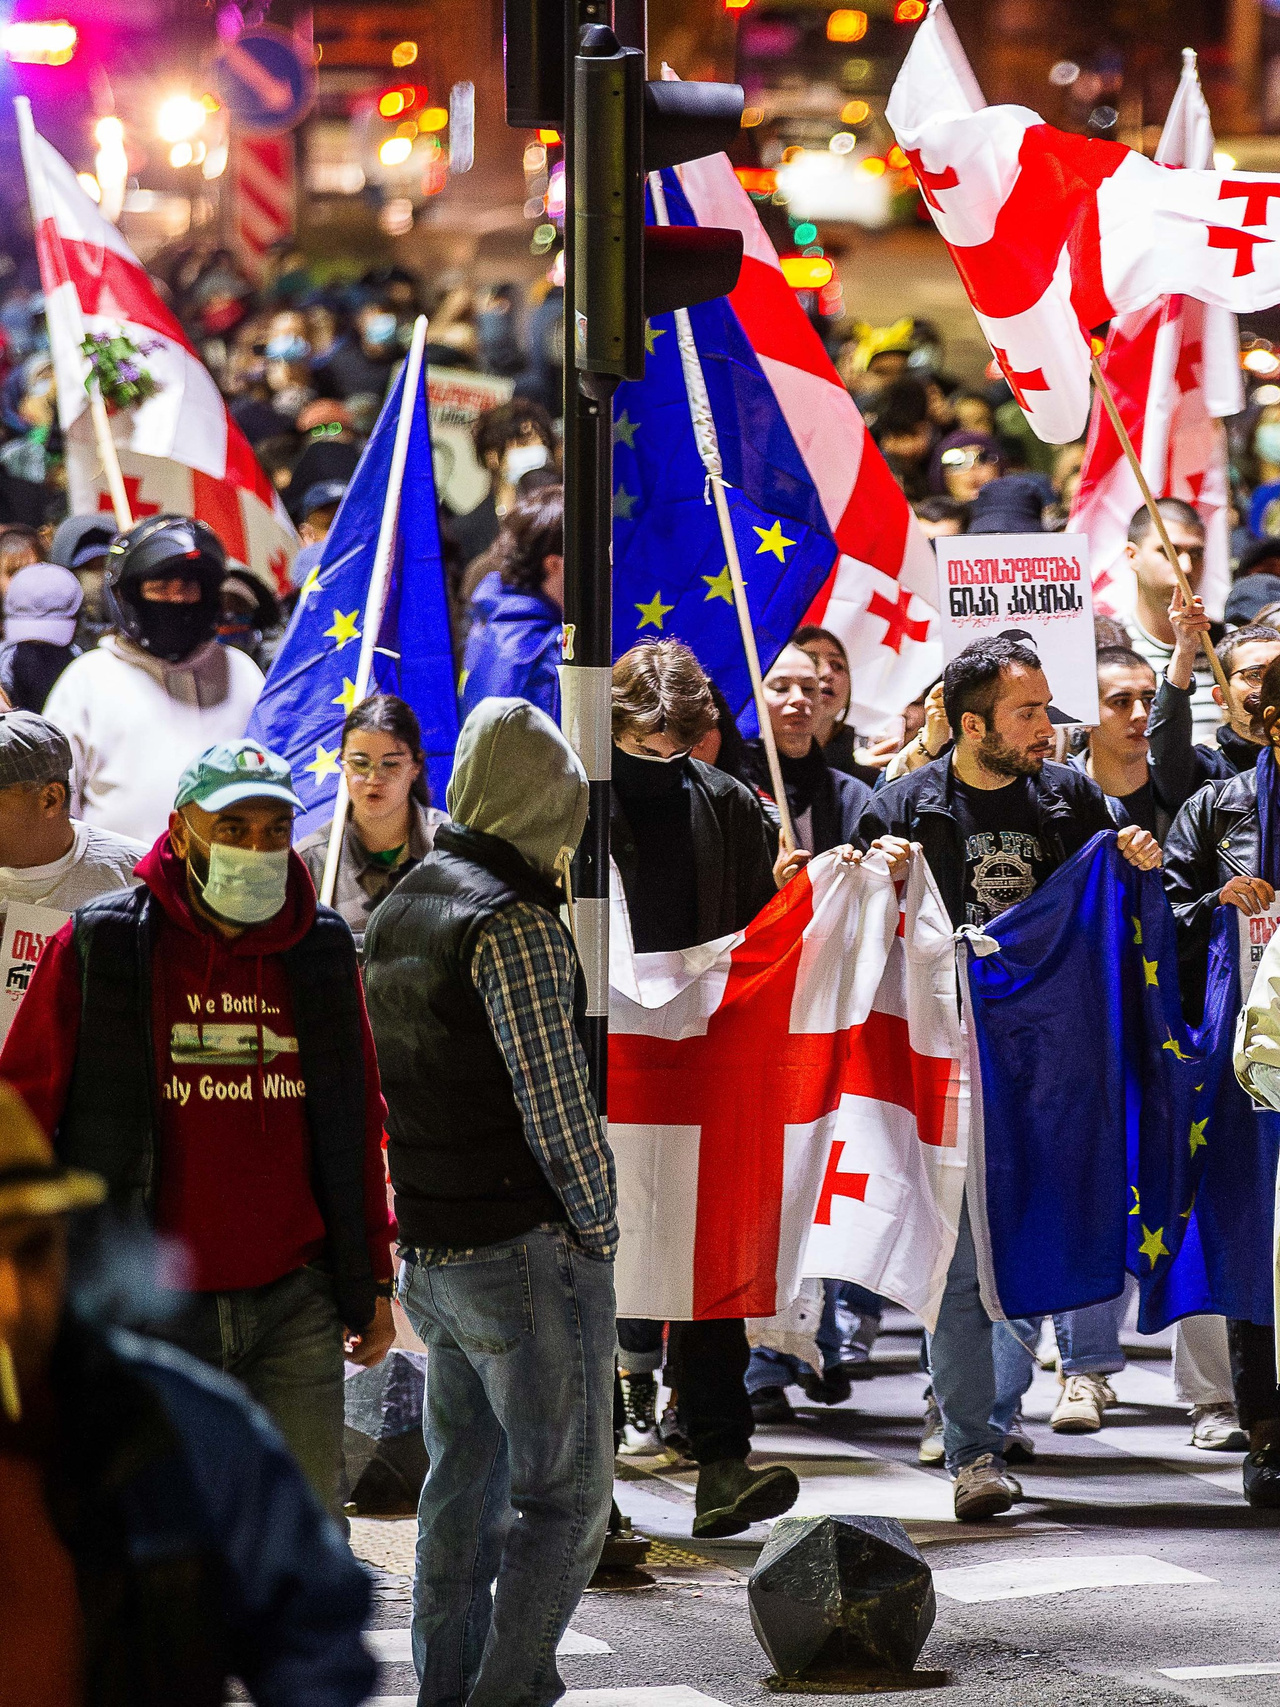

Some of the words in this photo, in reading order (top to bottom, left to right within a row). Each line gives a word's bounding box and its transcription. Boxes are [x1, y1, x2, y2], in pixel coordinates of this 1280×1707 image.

[948, 556, 1081, 585] თავისუფლება
[949, 586, 999, 616] ნიკა
[1007, 583, 1083, 615] კაციას
[187, 993, 215, 1014] We
[163, 1075, 191, 1107] nly
[199, 1074, 253, 1100] Good
